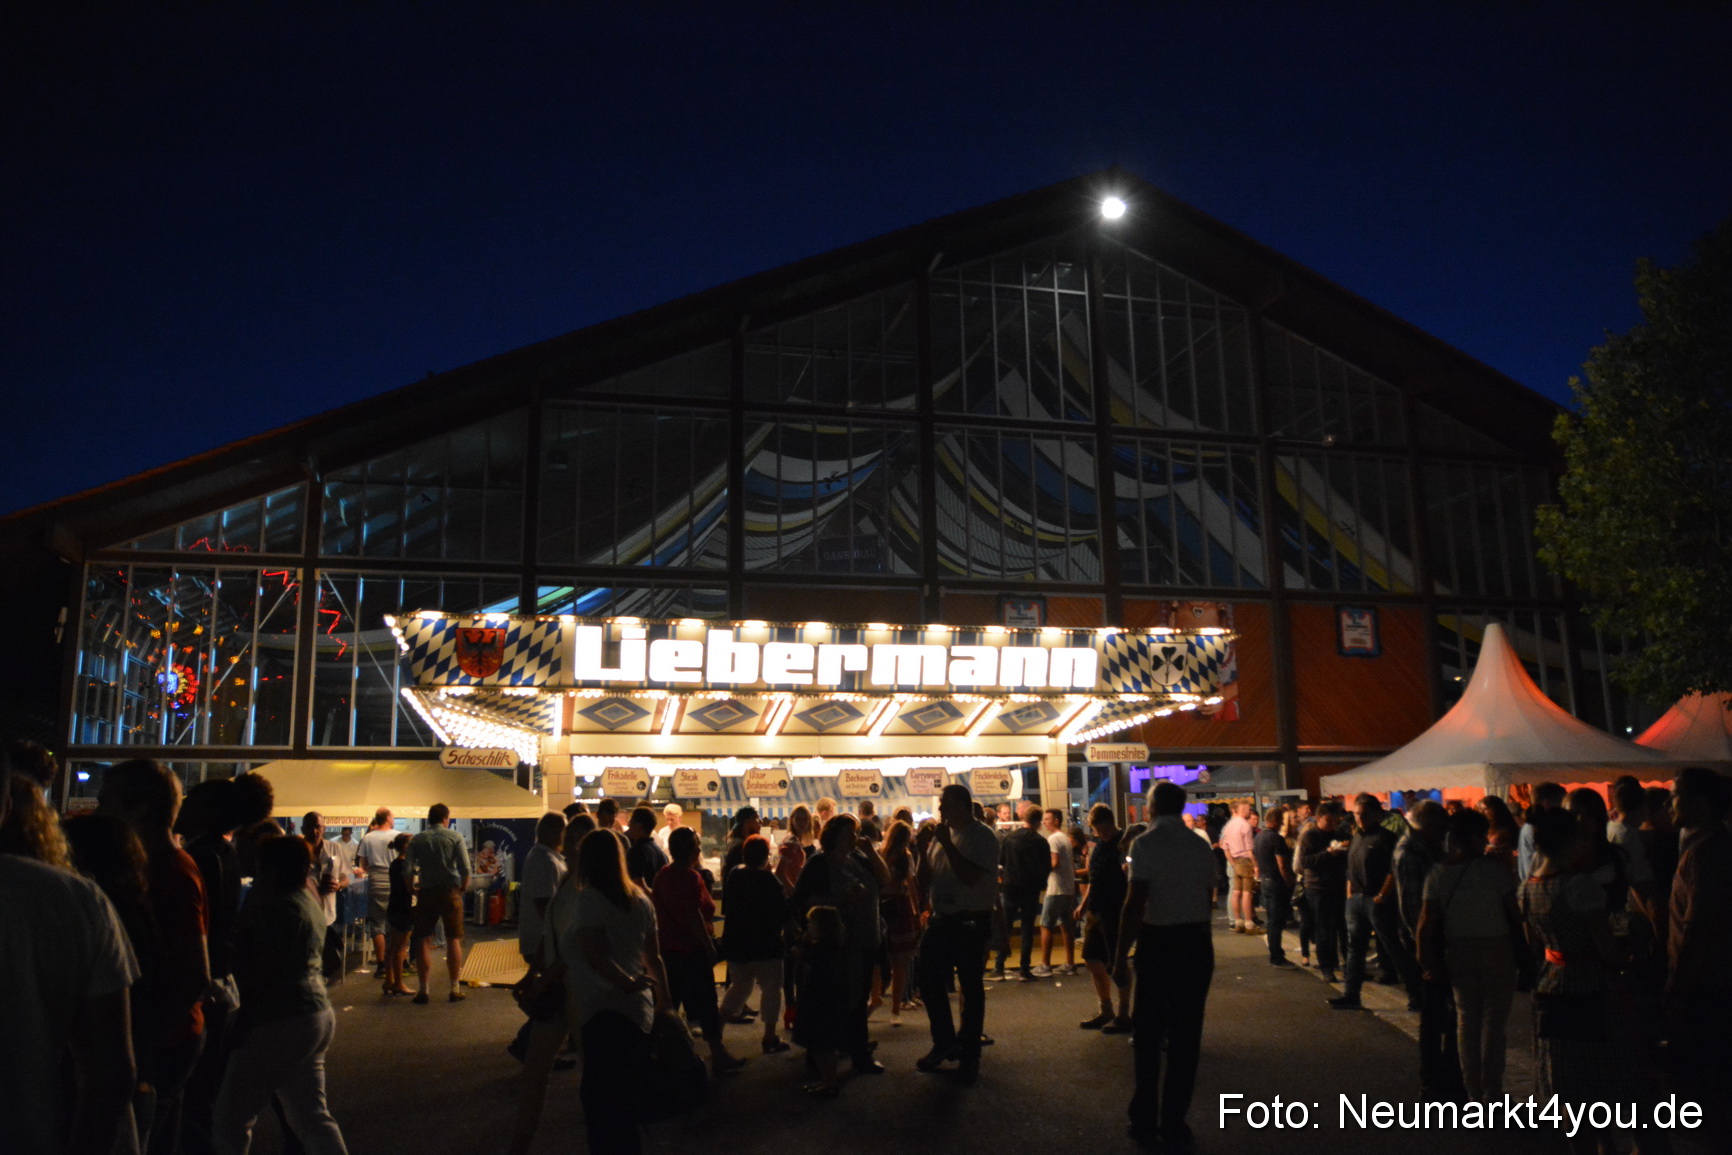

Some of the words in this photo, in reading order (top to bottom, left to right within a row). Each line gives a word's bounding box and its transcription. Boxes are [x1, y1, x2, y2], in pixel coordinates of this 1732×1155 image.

[574, 625, 1098, 688] Liebermann
[446, 749, 513, 766] Schaschlik
[1089, 746, 1146, 760] Pommesfrites
[607, 770, 638, 781] Frikadelle
[680, 771, 699, 782] Steak
[845, 772, 876, 783] Bockwurst
